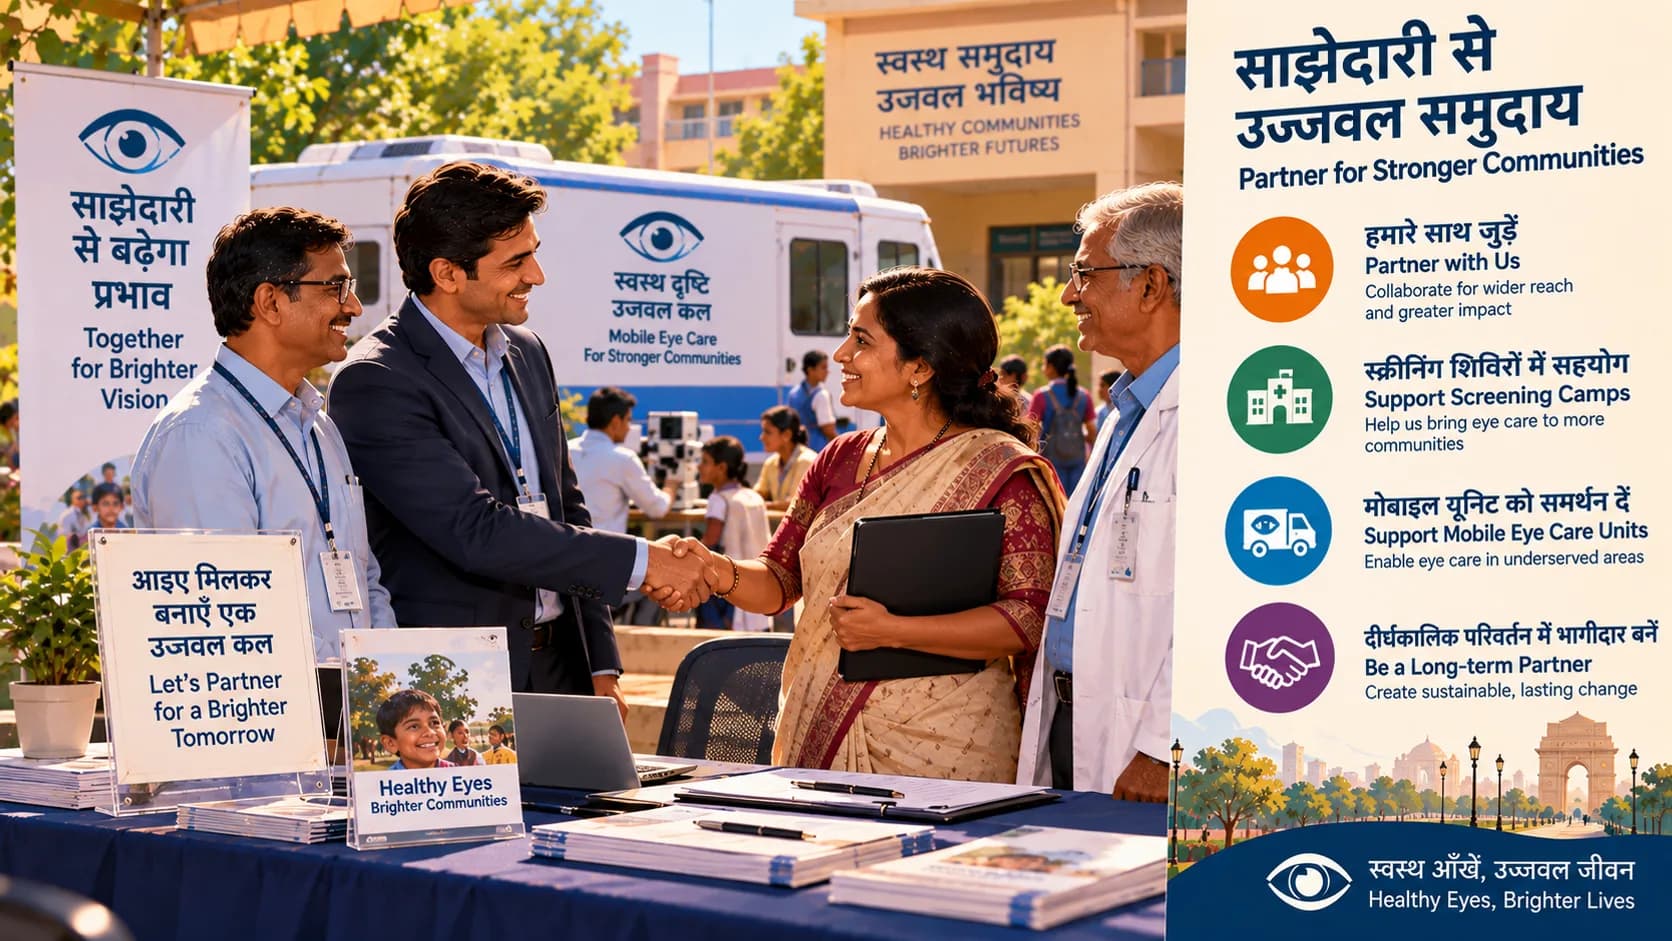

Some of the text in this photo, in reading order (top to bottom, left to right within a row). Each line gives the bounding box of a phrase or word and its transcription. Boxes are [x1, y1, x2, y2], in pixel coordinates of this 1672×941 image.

[875, 40, 1056, 77] स्वस्थ समुदाय
[1234, 15, 1496, 94] साझेदारी से
[975, 73, 1061, 105] भविष्य
[880, 114, 1080, 139] HEALTHY COMMUNITIES
[1235, 85, 1583, 149] उज्जवल समुदाय
[899, 136, 1059, 160] BRIGHTER FUTURES
[1240, 143, 1644, 190] Partner for Stronger Communities
[70, 184, 196, 226] साझेदारी
[1365, 214, 1518, 249] हमारे साथ जुड़ें
[72, 225, 190, 272] से बढ़ेगा
[1366, 252, 1520, 274] Partner with Us
[92, 281, 173, 309] प्रभाव
[614, 269, 710, 300] स्वस्थ दृष्टि
[1366, 278, 1573, 298] Collaborate for wider reach
[677, 303, 712, 320] कल
[1366, 302, 1512, 322] and greater impact
[84, 328, 184, 353] Together
[609, 329, 717, 348] Mobile Eye Care
[585, 348, 741, 367] For Stronger Communities
[1364, 348, 1630, 381] स्क्रीनिंग शिविरों में सहयोग
[72, 357, 197, 384] for Brighter
[101, 388, 168, 409] Vision
[1365, 385, 1630, 412] Support Screening Camps
[1366, 414, 1604, 434] Help us bring eye care to more
[1365, 436, 1464, 452] communities
[1363, 485, 1630, 522] मोबाइल यूनिट को समर्थन दें
[1365, 521, 1648, 548] Support Mobile Eye Care Units
[1365, 549, 1644, 571] Enable eye care in underserved areas
[133, 563, 272, 594] आइए मिलकर
[153, 596, 256, 627] बनाएँ एक
[231, 635, 273, 654] कल
[1463, 622, 1532, 646] परिवर्तन
[1537, 622, 1552, 644] में
[1557, 620, 1627, 645] भागीदार
[1631, 620, 1658, 643] बनें
[1366, 656, 1592, 679] Be a Long-term Partner
[207, 673, 282, 691] Partner
[1366, 681, 1637, 700] Create sustainable, lasting change
[154, 698, 287, 722] for a Brighter
[171, 728, 275, 747] Tomorrow
[380, 776, 492, 796] Healthy Eyes
[371, 795, 507, 816] Brighter Communities
[1368, 853, 1635, 883] स्वस्थ आँखें, उज्जवल जीवन
[1370, 890, 1634, 913] Healthy Eyes, Brighter Lives
